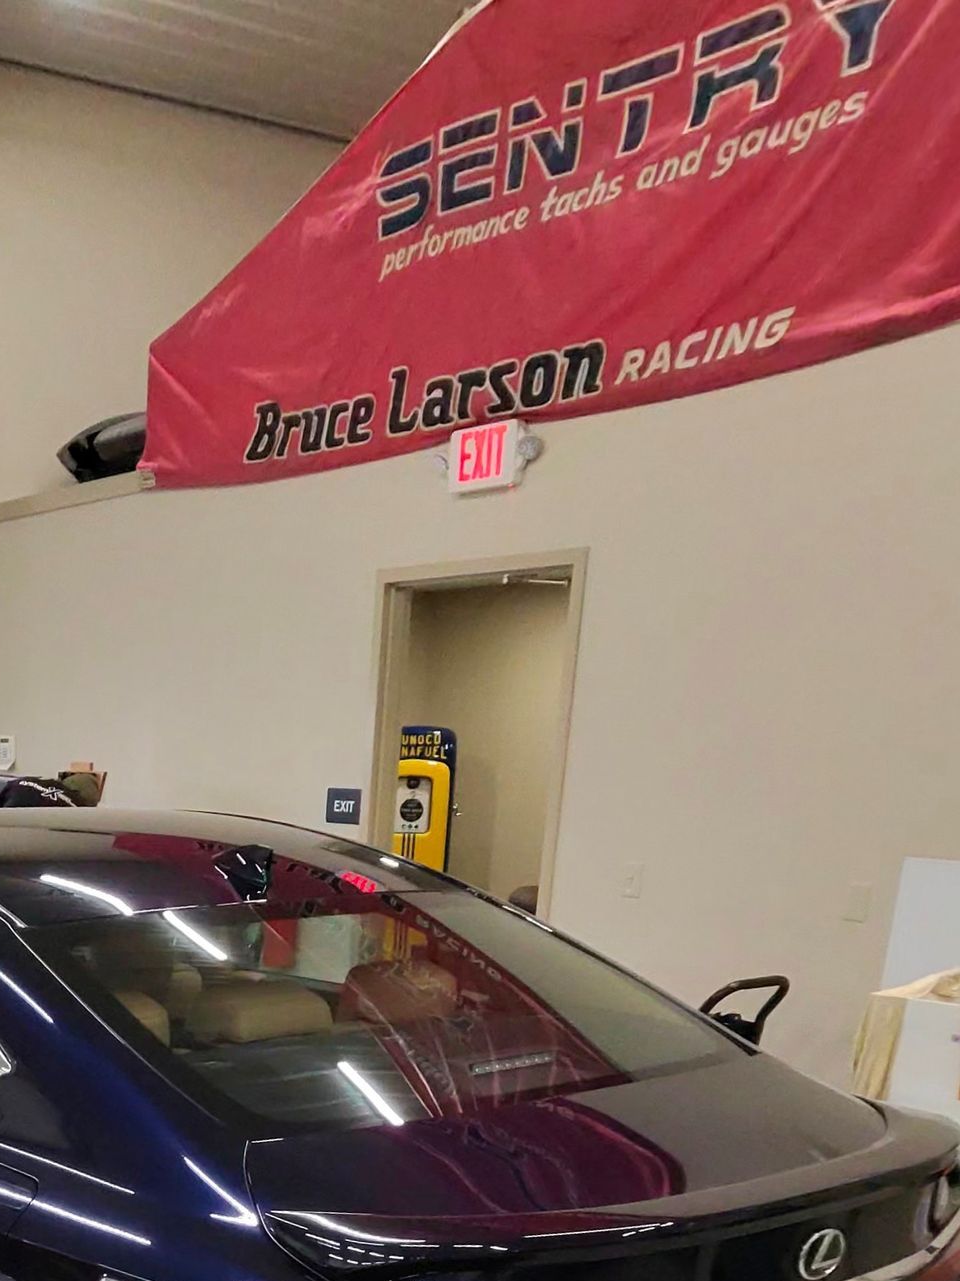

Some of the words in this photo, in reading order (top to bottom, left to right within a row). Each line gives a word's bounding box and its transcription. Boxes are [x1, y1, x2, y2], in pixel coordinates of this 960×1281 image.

[375, 0, 895, 241] SENTRY
[378, 206, 530, 282] performance
[540, 171, 623, 222] tachs
[636, 133, 713, 191] and
[710, 89, 870, 180] gauges
[242, 394, 376, 464] Bruce
[385, 337, 608, 436] Larson
[614, 306, 797, 385] RACING
[458, 423, 507, 483] EXIT
[401, 734, 441, 746] UNOCO
[334, 800, 355, 813] EXIT
